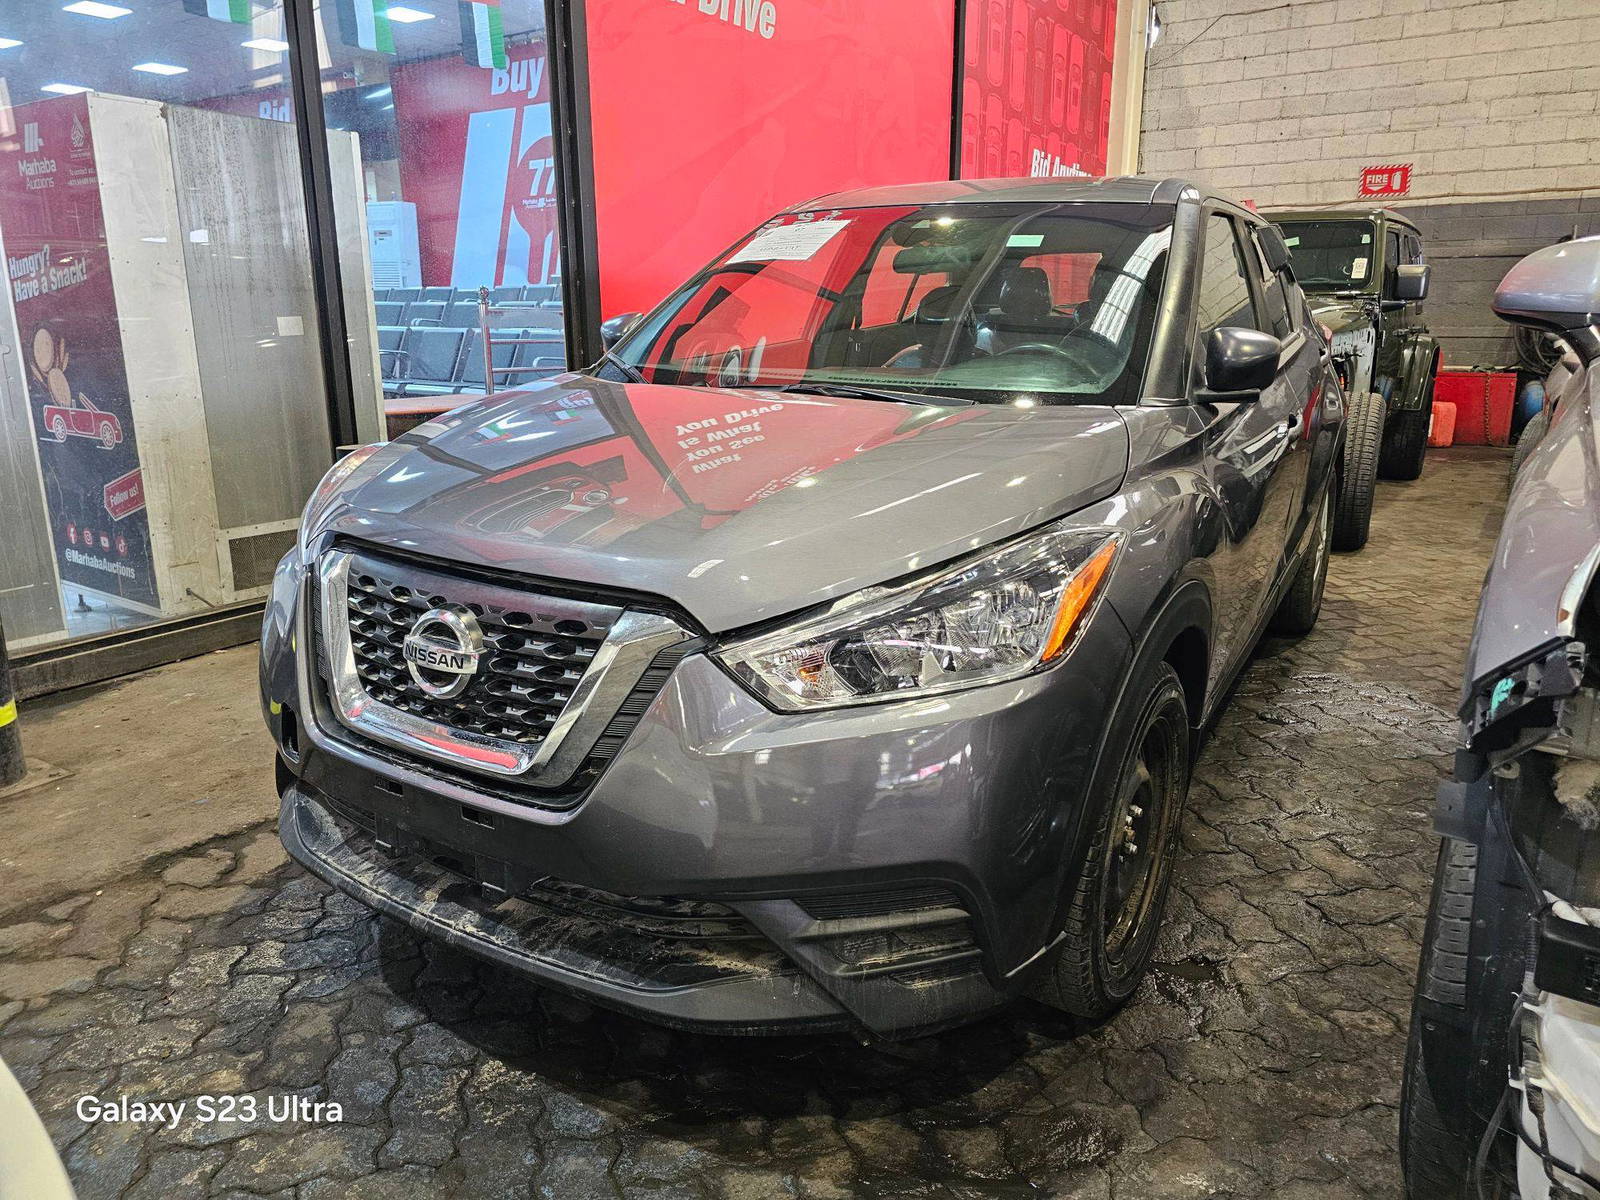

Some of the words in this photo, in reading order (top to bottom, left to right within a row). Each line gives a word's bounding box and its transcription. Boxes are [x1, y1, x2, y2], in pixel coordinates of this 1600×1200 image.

[491, 55, 545, 98] Buy
[18, 158, 57, 176] Marhaba
[1031, 148, 1051, 177] Bid
[26, 177, 55, 190] Auctions
[1366, 174, 1389, 185] FIRE
[9, 244, 50, 279] Hungry?
[14, 279, 40, 302] Have
[41, 275, 48, 294] a
[49, 257, 87, 291] Snack!
[110, 492, 129, 508] Follow
[65, 548, 136, 579] @MarhabaAuctions
[406, 641, 464, 670] NISSAN
